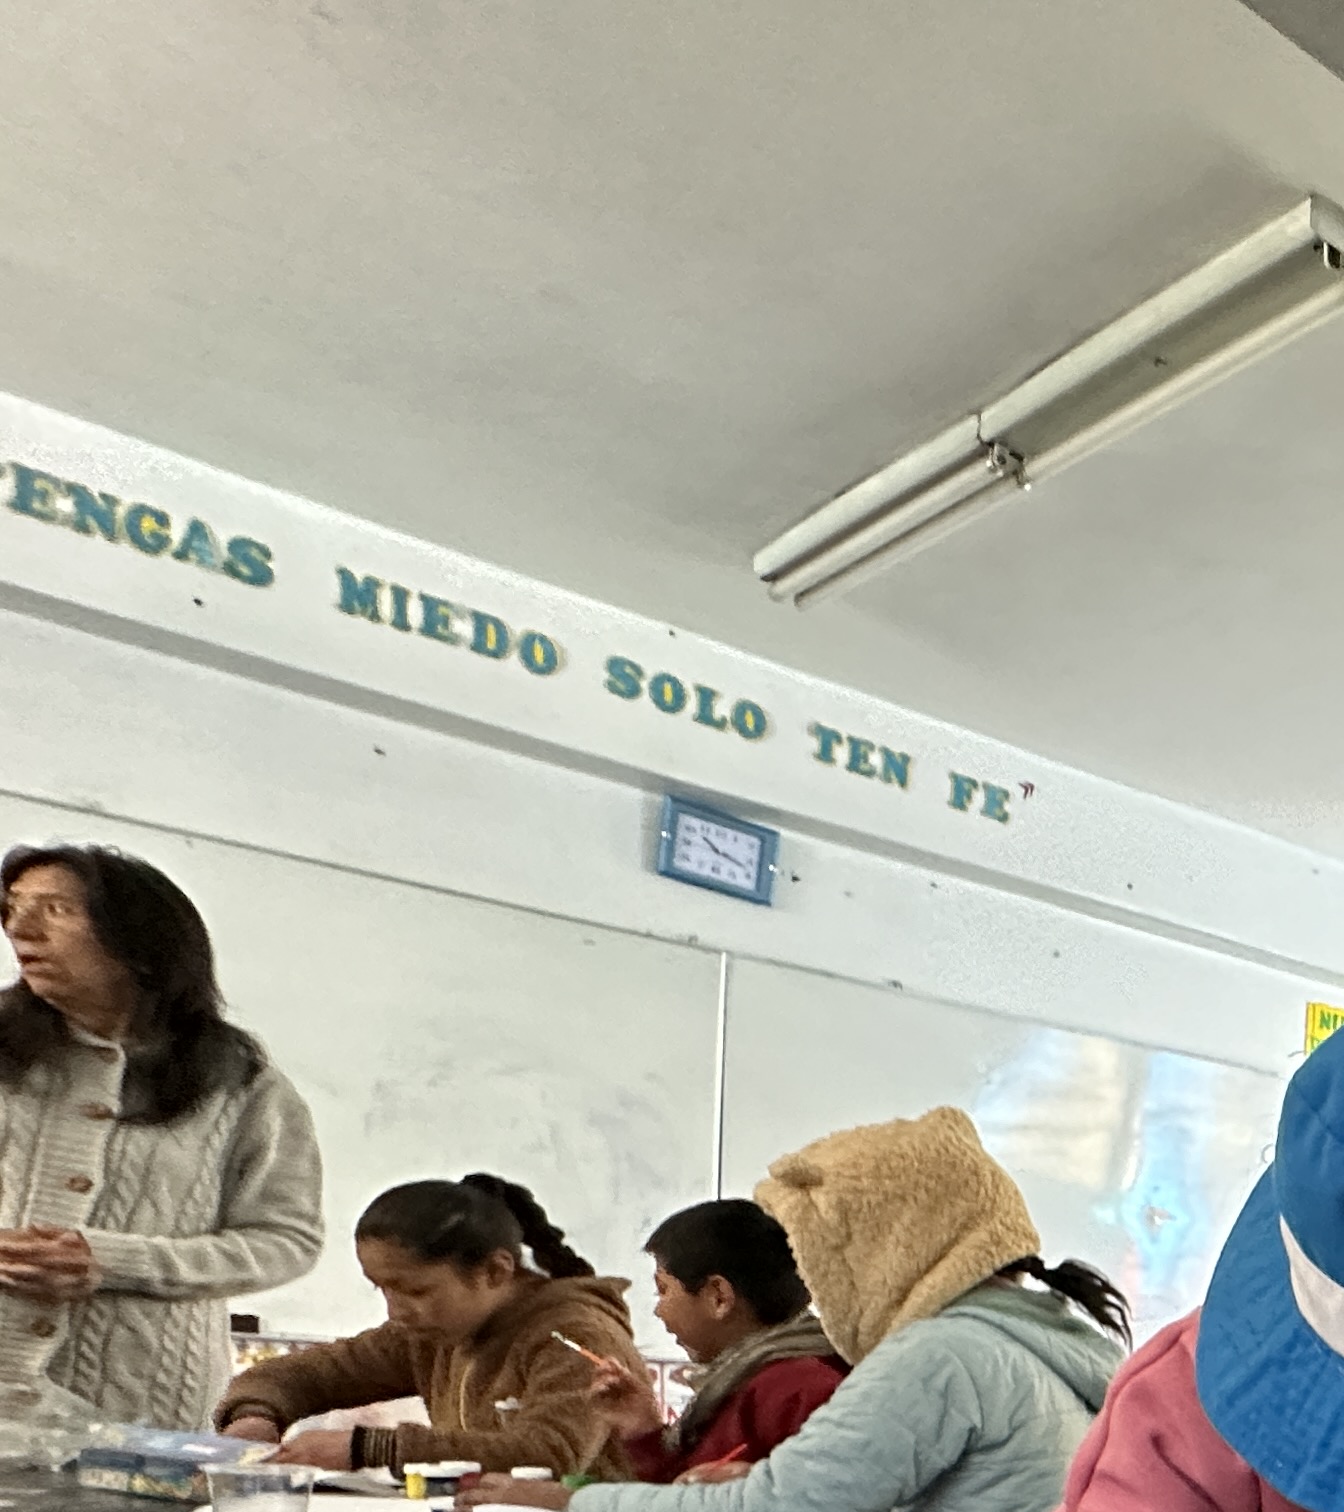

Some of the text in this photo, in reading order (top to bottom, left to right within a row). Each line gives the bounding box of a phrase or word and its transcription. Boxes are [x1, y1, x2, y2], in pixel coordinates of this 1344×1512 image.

[0, 460, 275, 588] ENGAS
[334, 564, 566, 677] MIEDO
[604, 655, 774, 742] SOLO
[807, 721, 911, 791] TEN
